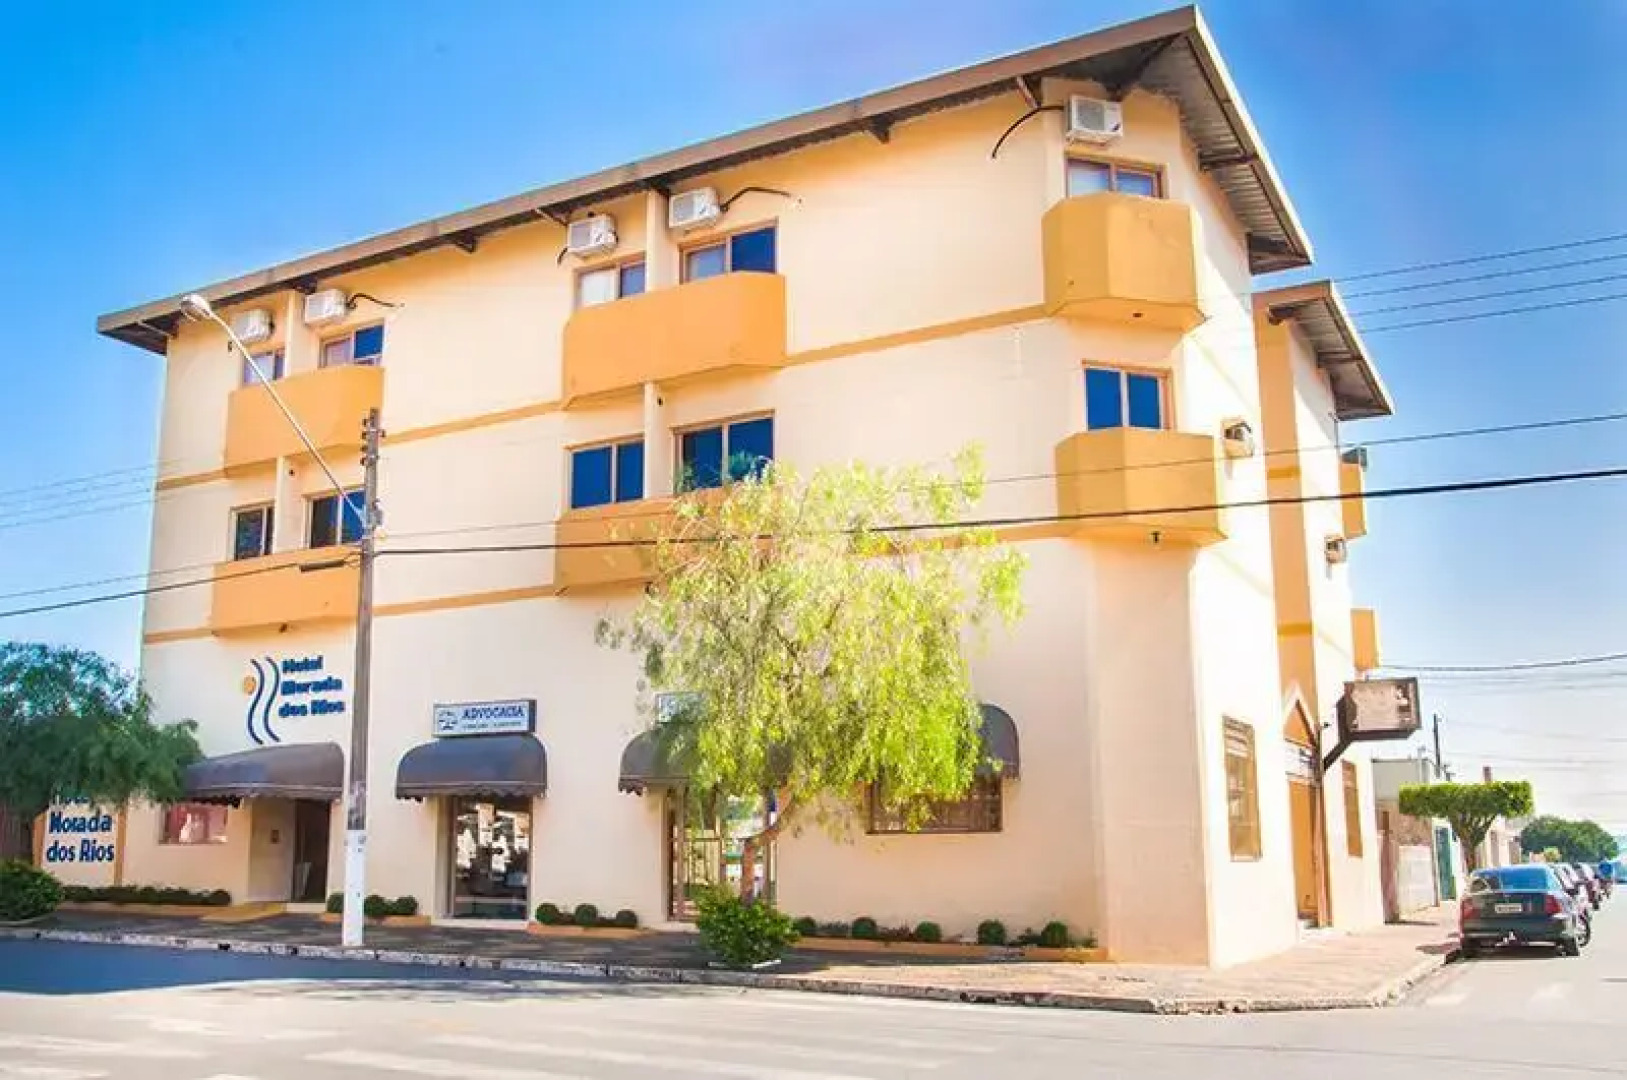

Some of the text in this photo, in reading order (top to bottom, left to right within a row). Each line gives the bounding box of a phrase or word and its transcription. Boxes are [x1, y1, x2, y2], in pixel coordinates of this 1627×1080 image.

[282, 655, 323, 673] Hotel
[281, 677, 342, 695] Morada
[279, 699, 345, 718] dos Rios
[50, 810, 112, 833] Morada
[47, 838, 114, 862] dos Rios
